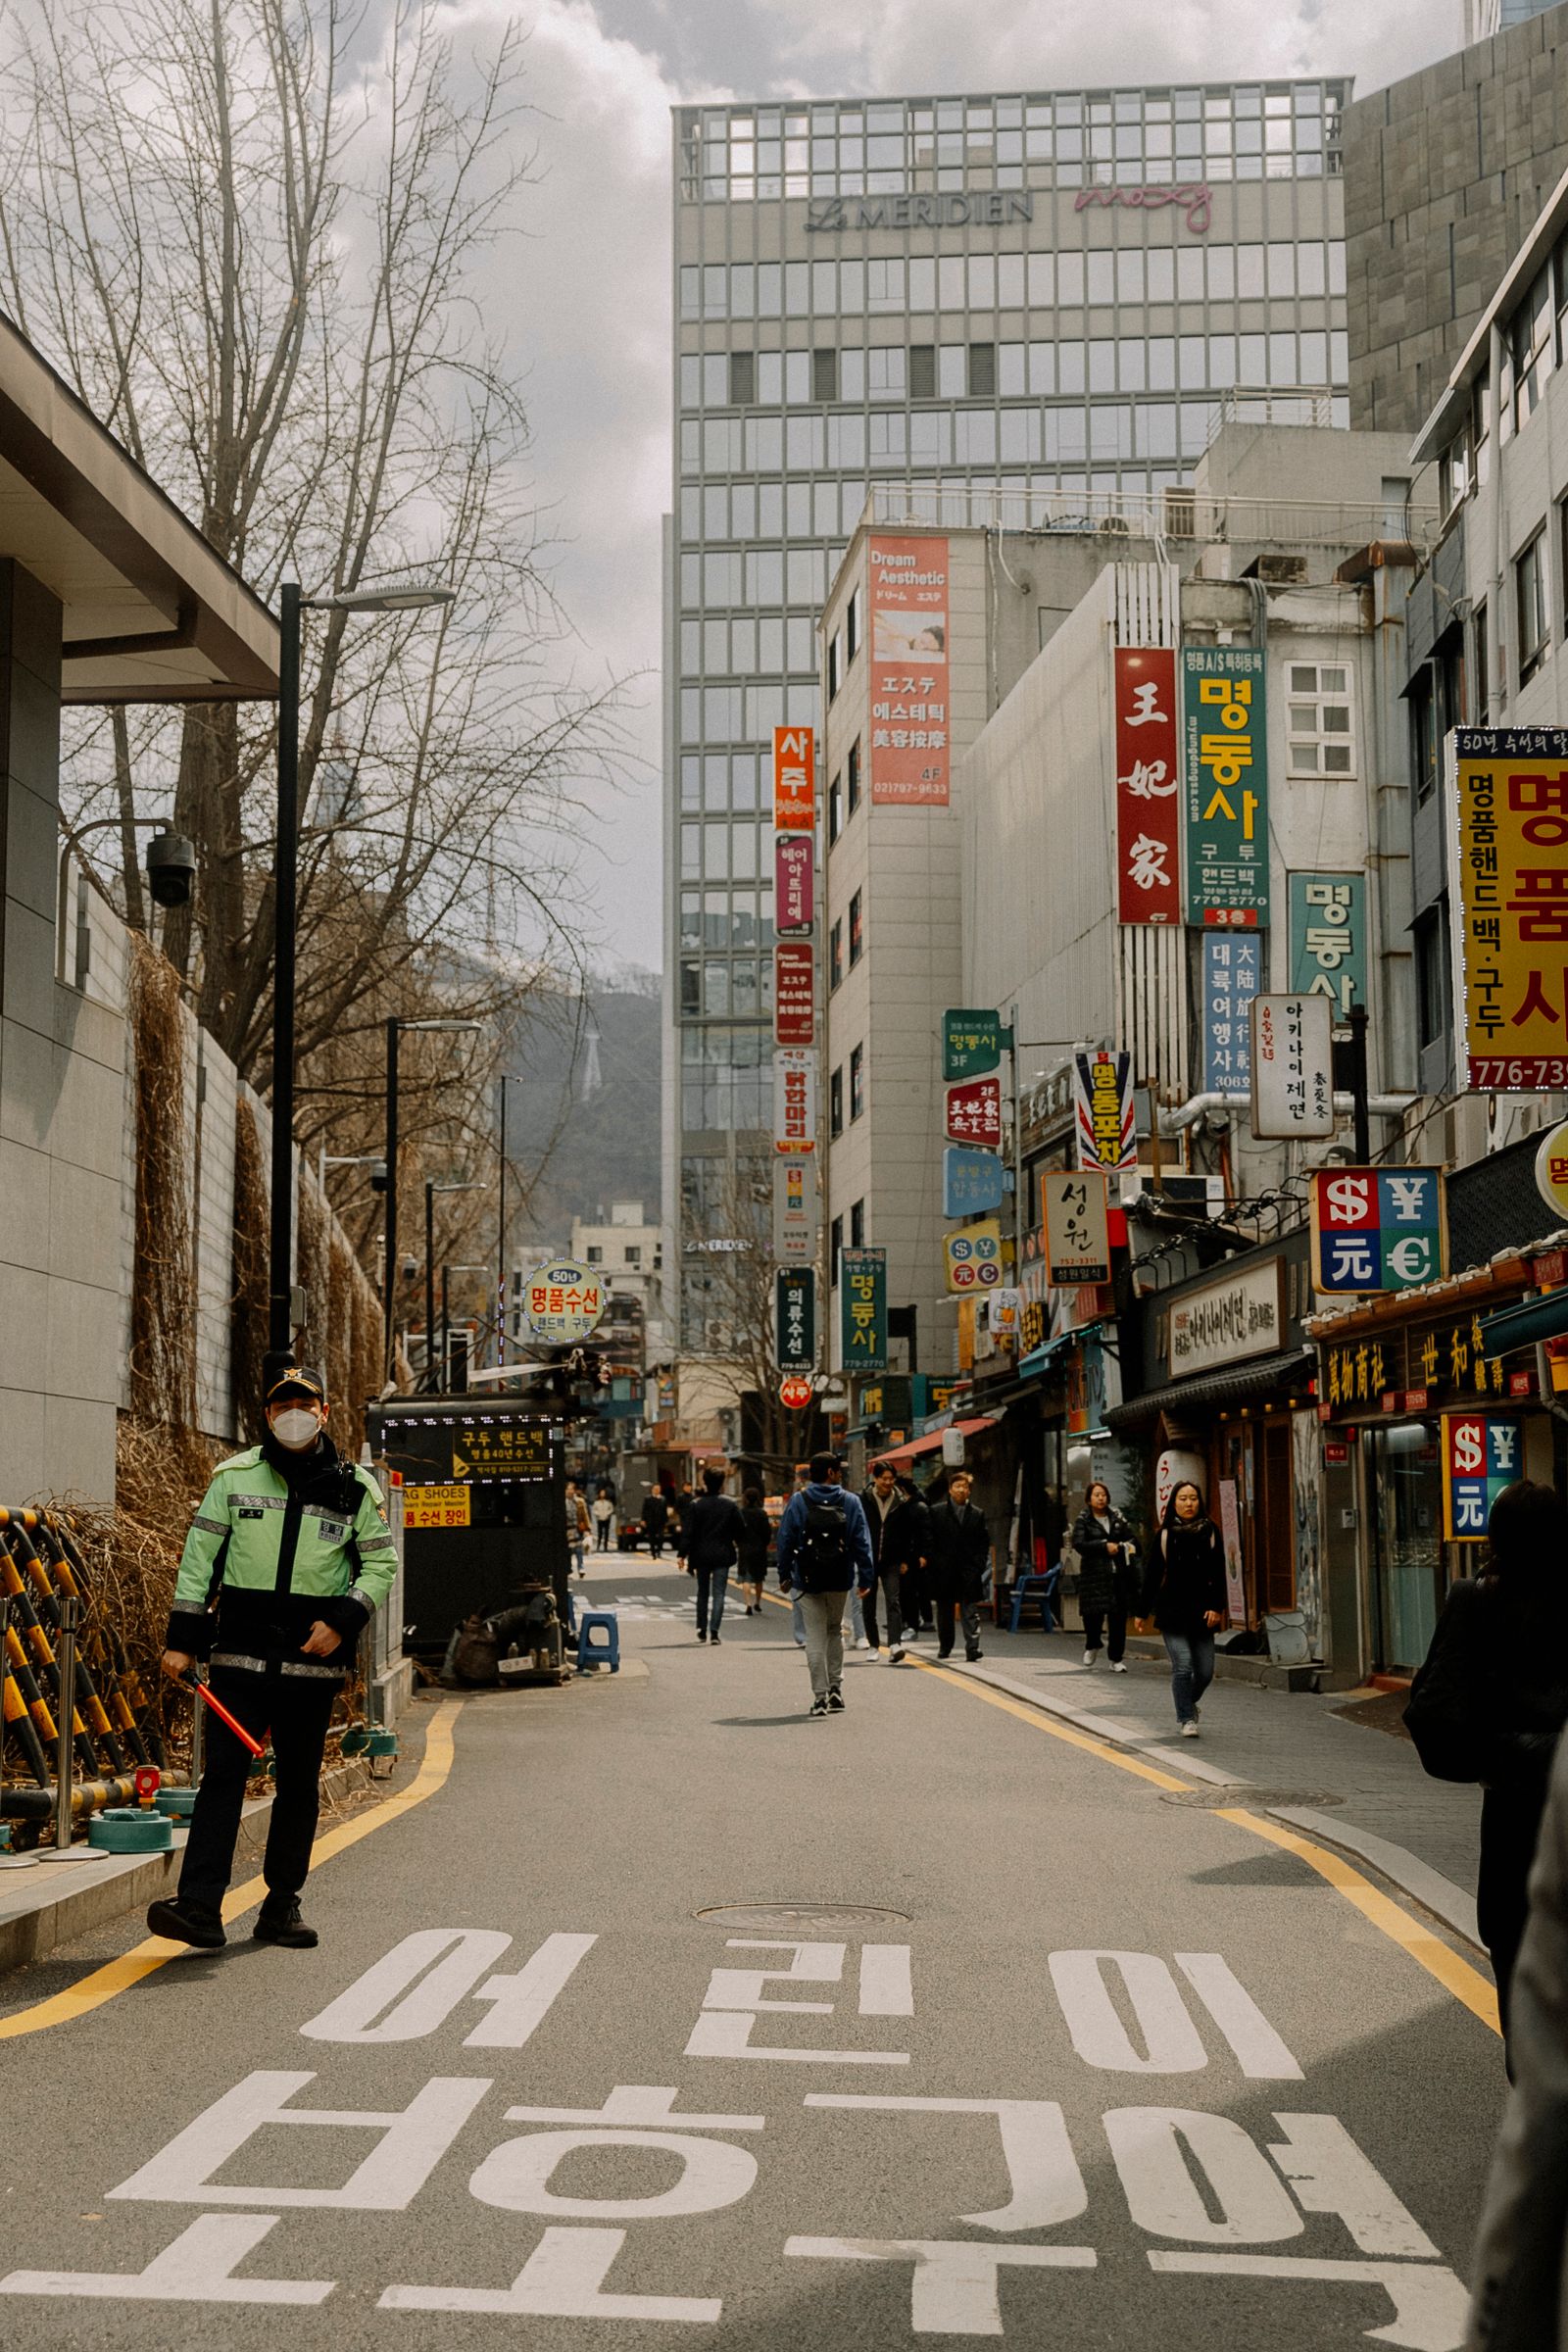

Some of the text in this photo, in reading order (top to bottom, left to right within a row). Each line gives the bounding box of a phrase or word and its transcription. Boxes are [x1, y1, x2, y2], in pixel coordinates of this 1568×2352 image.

[805, 192, 1033, 232] Le MERIDIEN
[871, 551, 915, 566] Dream
[878, 570, 945, 585] Aesthetic
[882, 677, 936, 694] エステ
[873, 702, 945, 722] 에스테틱
[1463, 733, 1498, 754] 50년
[1504, 732, 1547, 754] 수선의
[780, 731, 808, 797] 사주
[1189, 716, 1200, 823] myungdongsa.com
[1200, 678, 1258, 840] 명동사
[921, 767, 941, 780] 4F
[1117, 682, 1177, 890] 王妃家
[1201, 844, 1254, 860] 구두
[1201, 867, 1254, 886] 핸드백
[1193, 896, 1268, 906] 779-2770
[1216, 909, 1247, 924] 3층
[1305, 884, 1354, 1013] 명동사
[1211, 944, 1232, 1072] 대륙여행사
[950, 1034, 997, 1052] 명동사
[951, 1054, 967, 1067] 3F
[1286, 1002, 1306, 1120] 아키나이제면
[1475, 1060, 1568, 1085] 776-73
[981, 1086, 995, 1097] 2F
[1091, 1063, 1122, 1165] 명동포차
[1327, 1176, 1428, 1224] $ ¥
[1061, 1183, 1093, 1251] 성원
[1332, 1237, 1431, 1281] 元 €
[552, 1271, 577, 1282] 50년
[532, 1288, 597, 1313] 명품수선
[572, 1318, 591, 1330] 구두
[787, 1289, 804, 1354] 의류수선
[851, 1275, 876, 1354] 명동사
[462, 1431, 543, 1447] 구두 핸드백
[1455, 1423, 1517, 1472] $ ¥
[403, 1488, 466, 1500] AG SHOES
[405, 1509, 466, 1526] 품 수선 장인
[1457, 1486, 1484, 1529] 元
[320, 1531, 341, 1543] POLICE
[298, 1927, 1305, 2080] 어린이
[0, 2070, 1474, 2352] 보호구역
